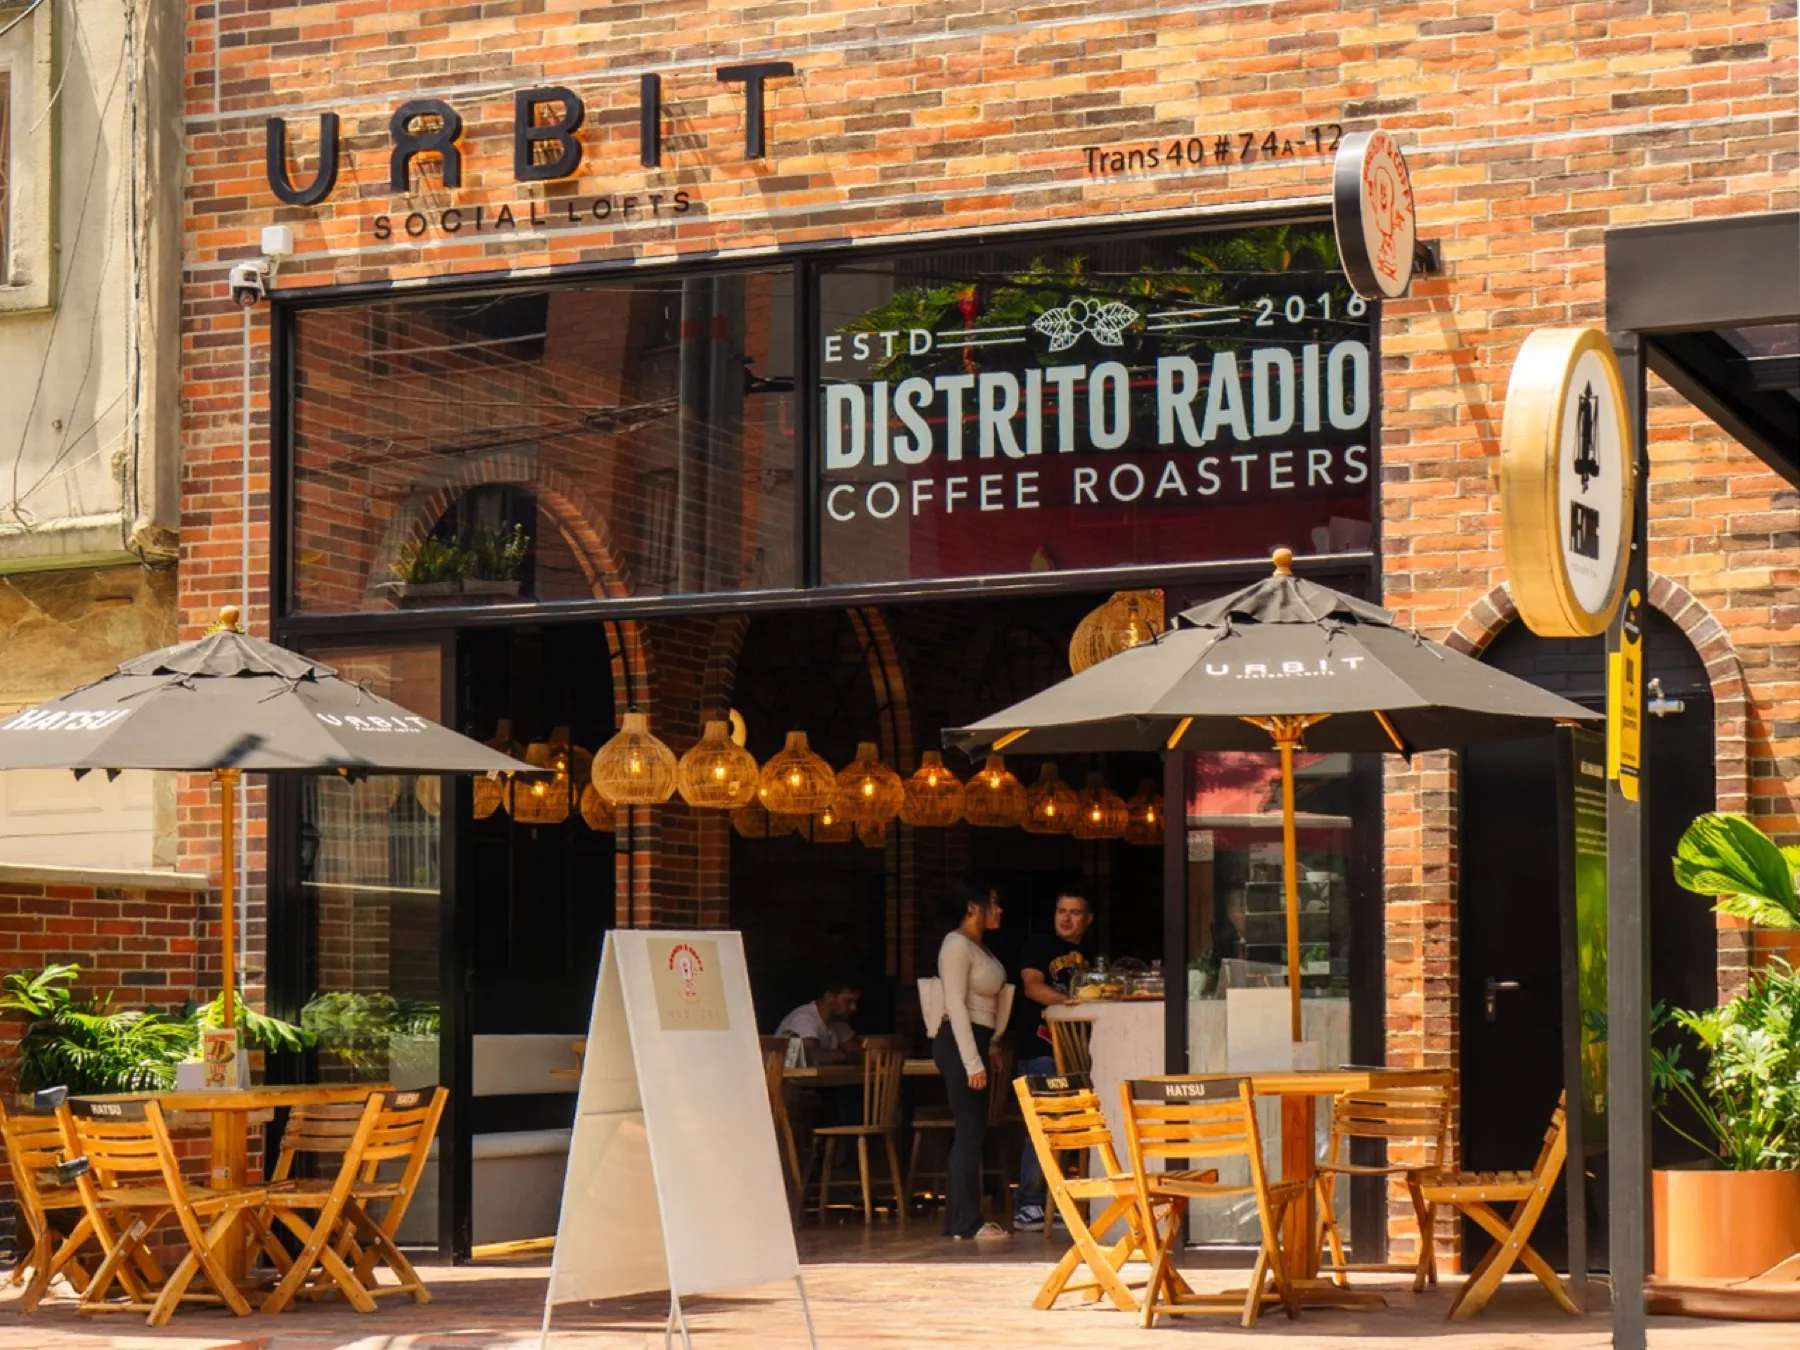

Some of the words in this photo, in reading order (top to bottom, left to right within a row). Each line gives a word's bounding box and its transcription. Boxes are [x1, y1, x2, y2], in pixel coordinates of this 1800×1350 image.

[265, 60, 795, 207] URBIT
[1082, 146, 1160, 173] Trans
[1166, 137, 1204, 166] 40
[373, 203, 547, 240] SOCIAL
[567, 191, 692, 223] LOFTS
[824, 328, 934, 363] ESTD
[1255, 293, 1368, 327] 2016
[825, 361, 1132, 470] DISTRITO
[1156, 340, 1371, 448] RADIO
[826, 471, 1041, 522] COFFEE
[1073, 445, 1369, 505] ROASTERS
[1205, 656, 1364, 677] URBIT
[1, 708, 132, 731] HATSU
[90, 1103, 122, 1116] HATSU
[1165, 1083, 1206, 1097] HATSU
